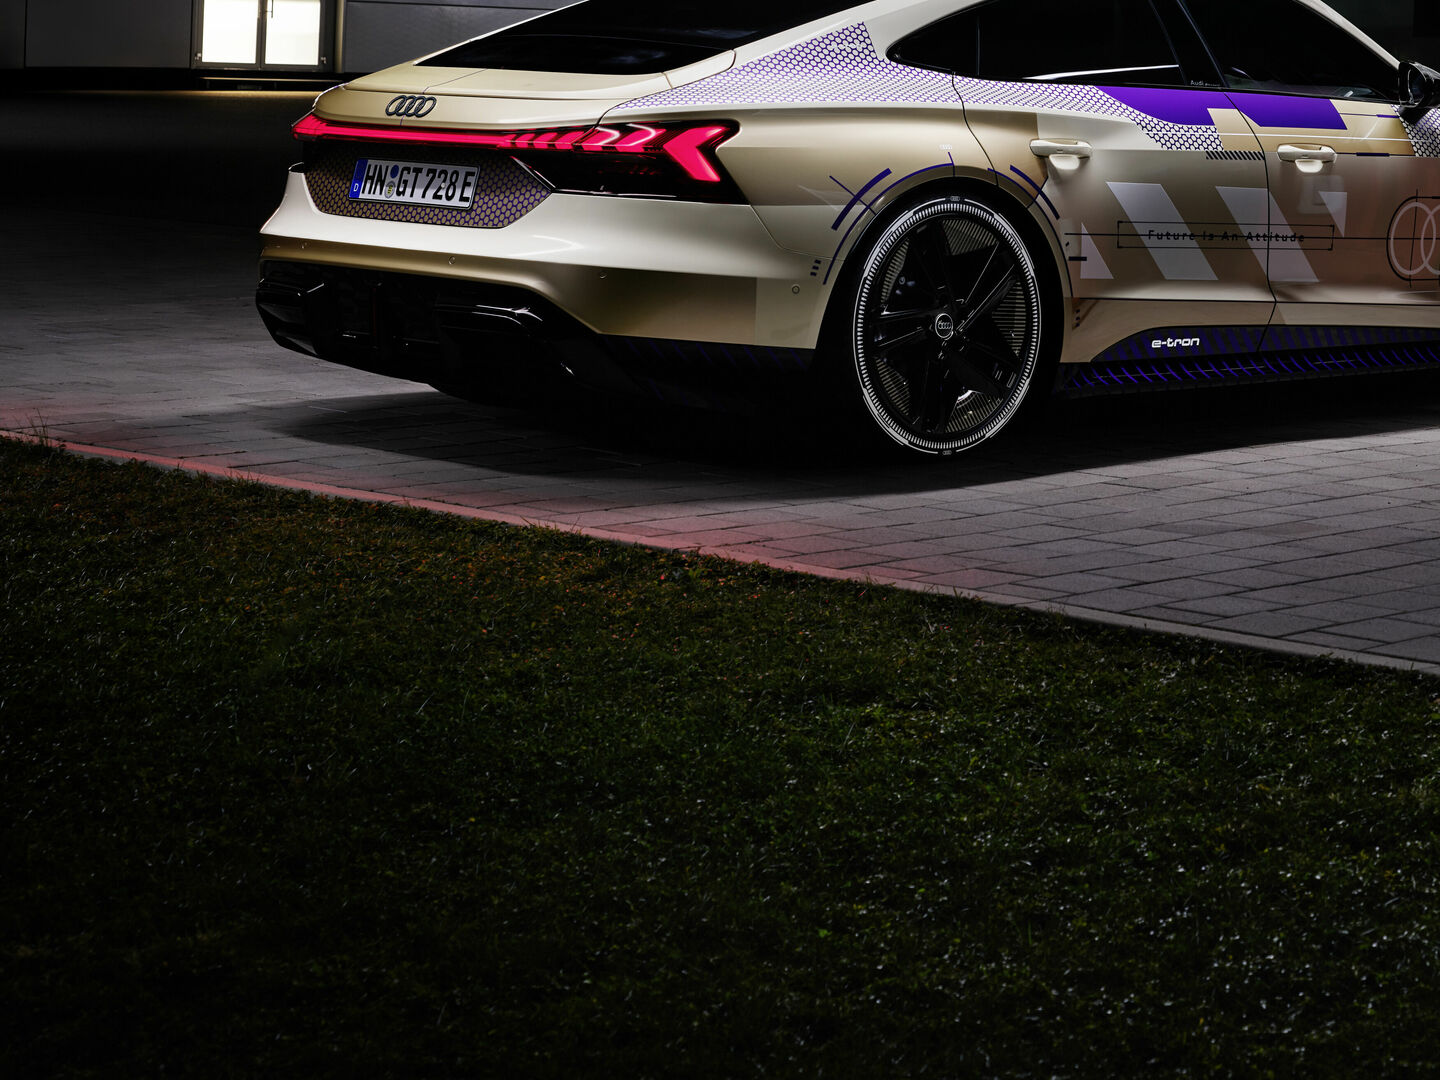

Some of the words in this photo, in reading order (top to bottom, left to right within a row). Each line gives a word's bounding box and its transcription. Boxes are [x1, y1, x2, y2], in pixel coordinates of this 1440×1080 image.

[361, 164, 389, 195] HN
[396, 166, 423, 197] GT
[353, 183, 359, 192] D
[1148, 230, 1195, 241] Future
[1221, 231, 1238, 241] An
[1246, 231, 1305, 242] Attitude
[1151, 336, 1200, 348] e-tron
